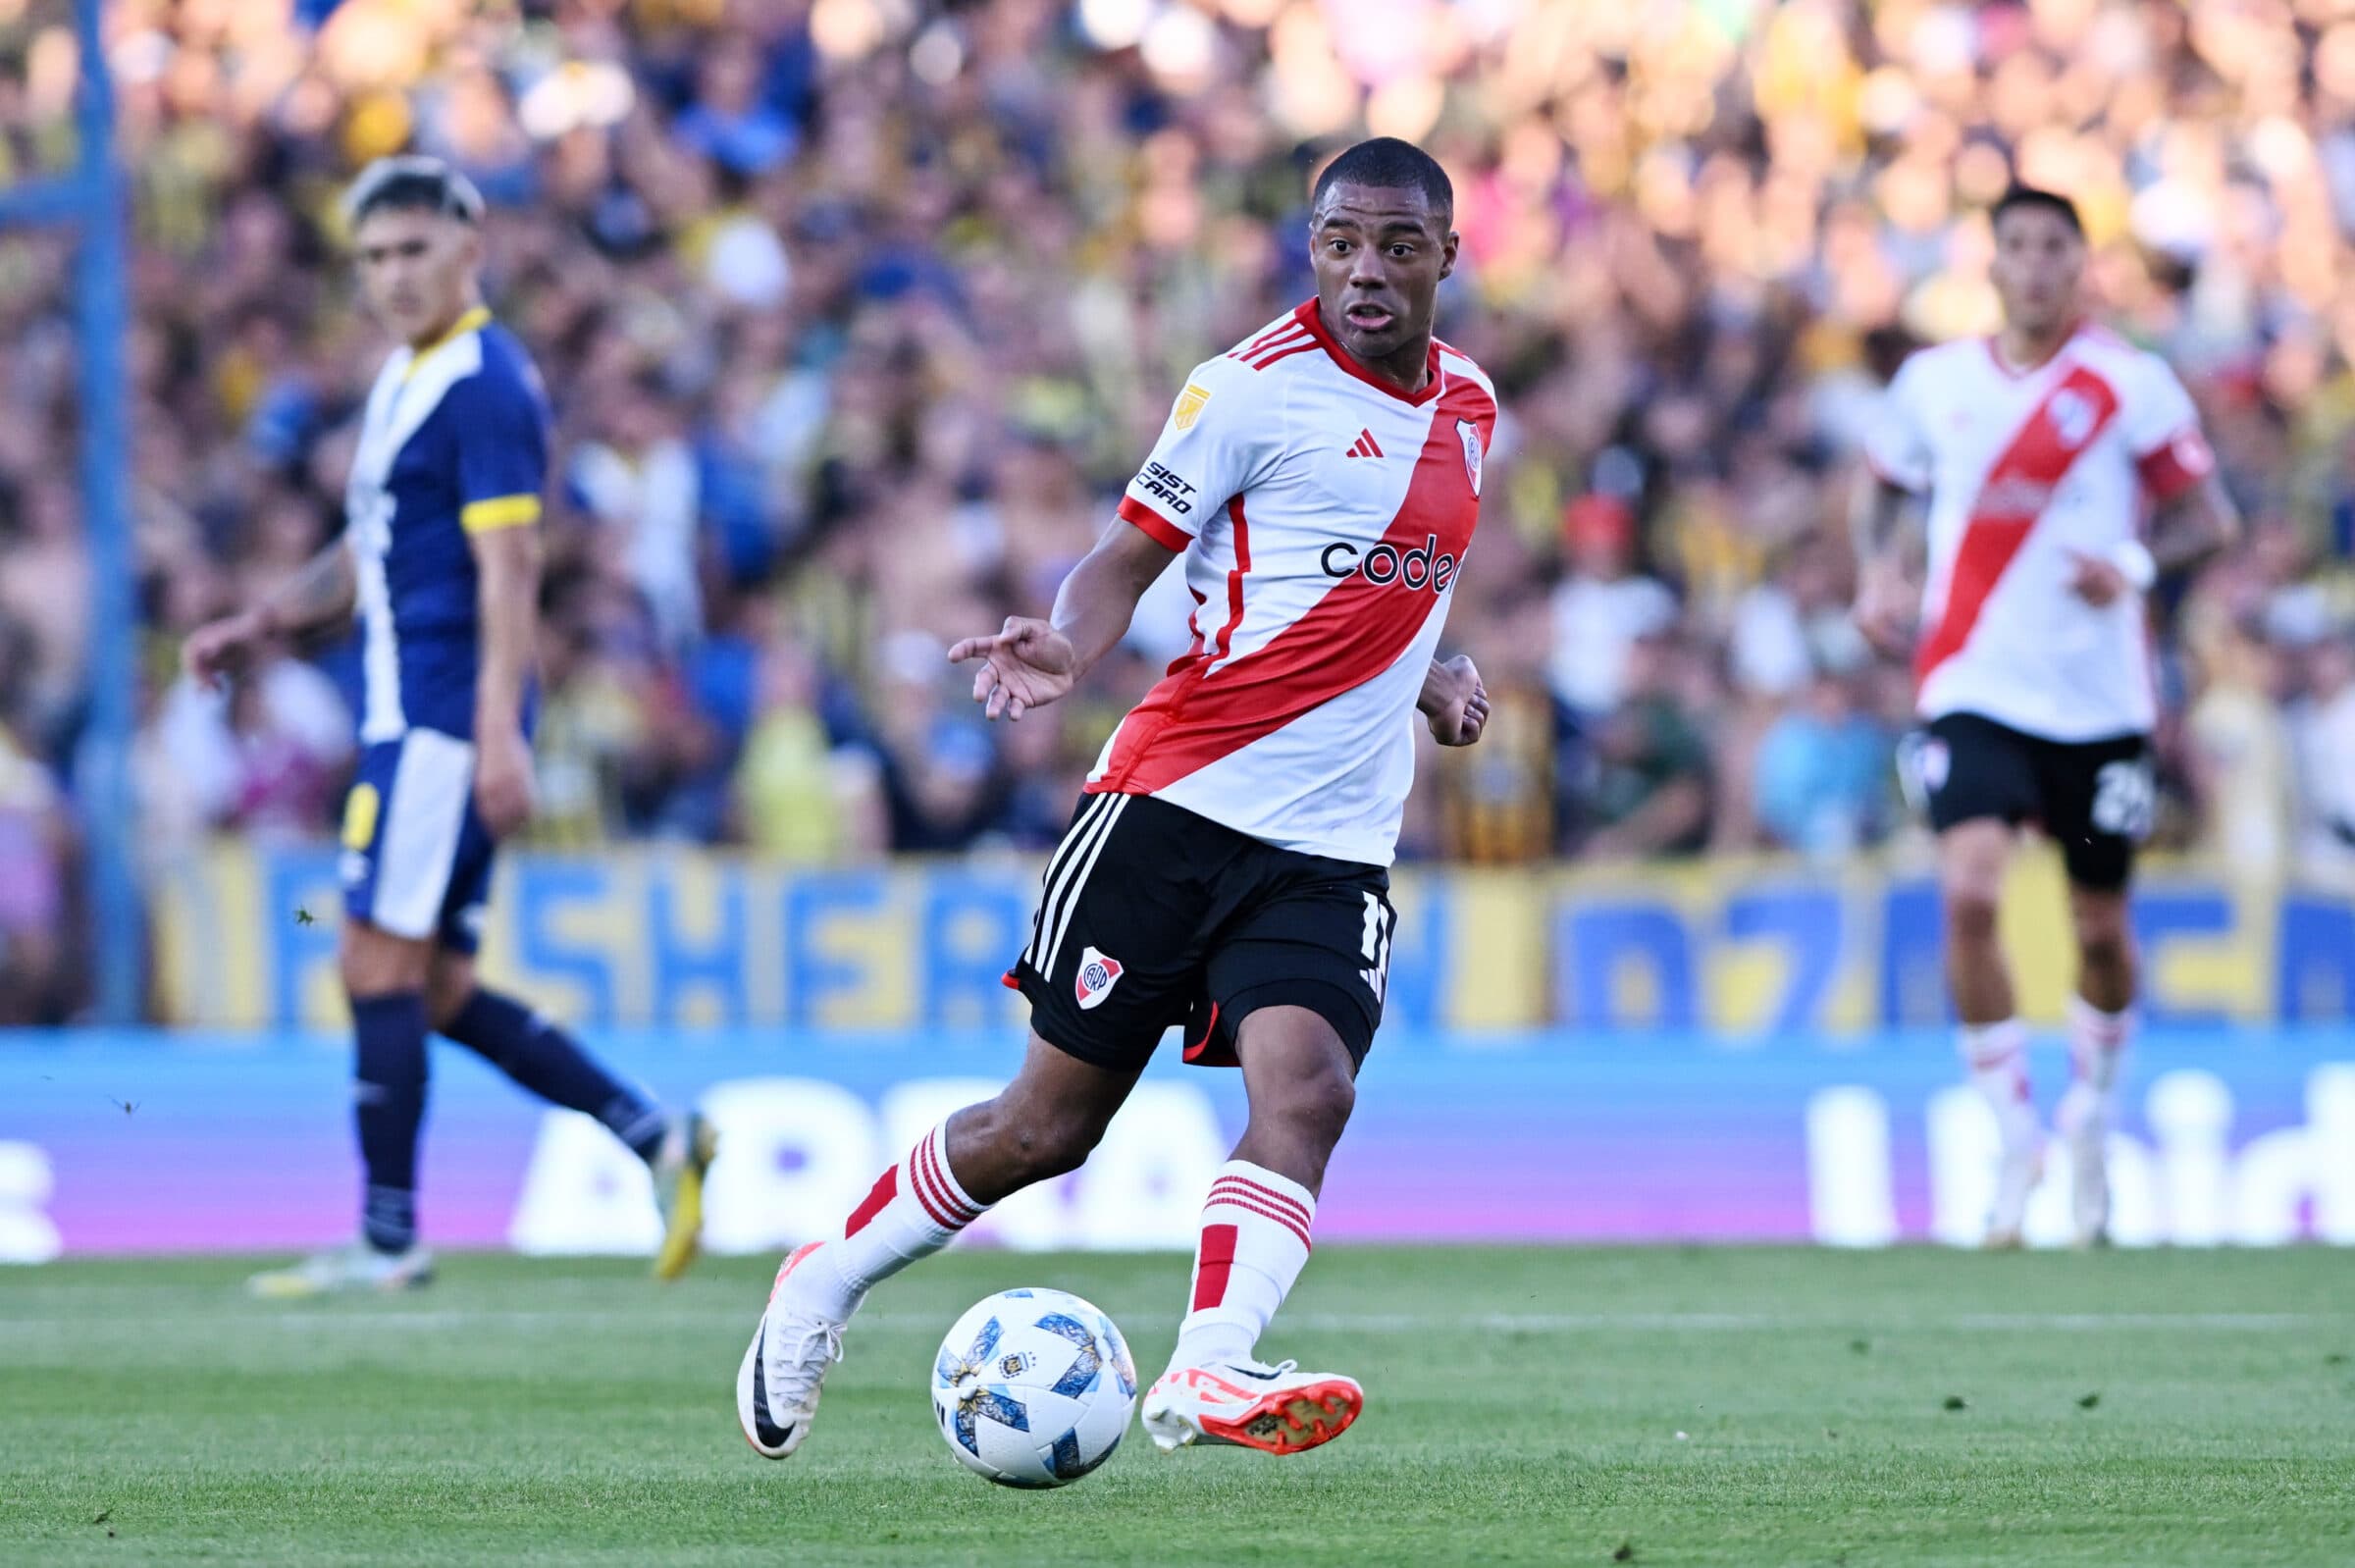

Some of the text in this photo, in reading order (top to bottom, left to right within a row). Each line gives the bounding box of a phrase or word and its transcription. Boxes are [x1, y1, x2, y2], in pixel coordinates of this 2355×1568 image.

[1135, 472, 1192, 515] CARD
[1146, 461, 1197, 495] SIST
[1321, 534, 1462, 595] code
[1360, 890, 1389, 979] 11
